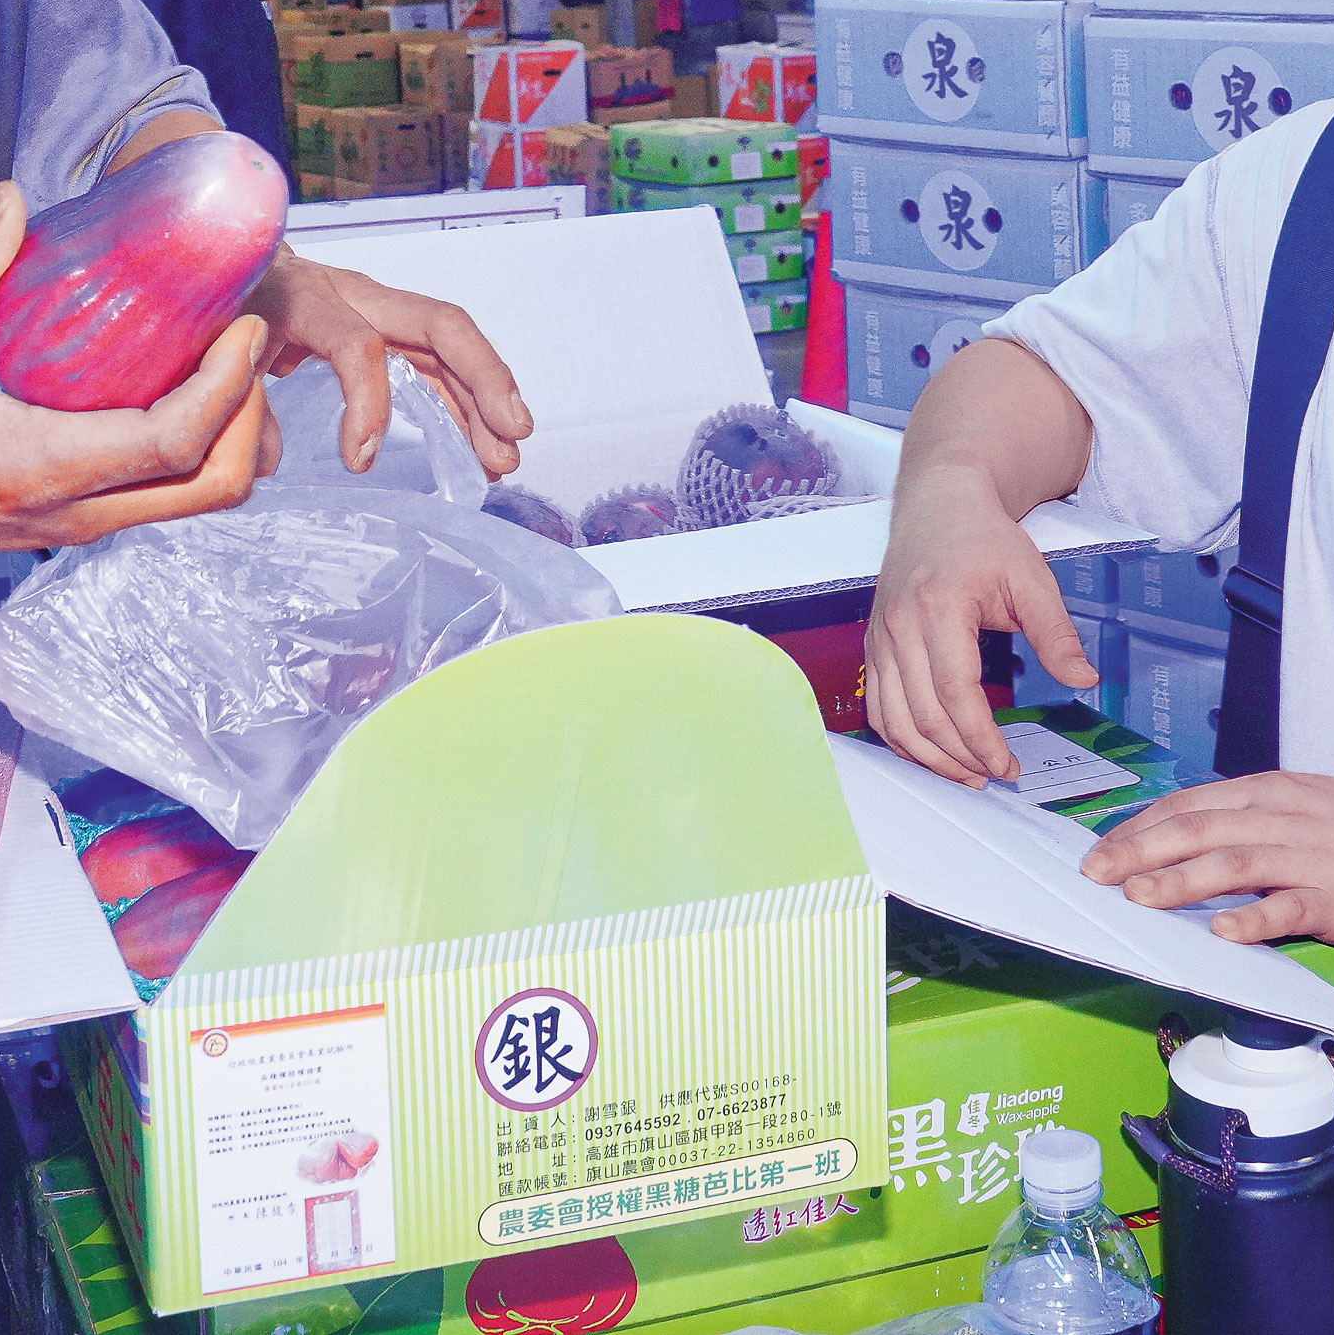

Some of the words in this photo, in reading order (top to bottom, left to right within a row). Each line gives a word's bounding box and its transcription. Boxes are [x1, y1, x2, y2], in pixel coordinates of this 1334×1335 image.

[922, 31, 969, 100] 泉
[1214, 64, 1261, 139] 泉
[938, 183, 986, 251] 泉
[1042, 753, 1084, 771] 公斤
[491, 1006, 585, 1094] 銀
[585, 1099, 637, 1123] 謝雪銀
[585, 1113, 681, 1141] 0937645592
[697, 1094, 787, 1122] 07-6623877
[968, 1099, 981, 1128] 佳冬
[993, 1085, 1064, 1111] Jiadong
[996, 1103, 1061, 1126] Wax-apple
[585, 1101, 842, 1163] 高雄市旗山區旗甲路一段280-1號
[586, 1128, 815, 1183] 旗山農會00037-22-1354860
[888, 1098, 1066, 1204] 黑珍
[498, 1149, 841, 1238] 農委會授權黑糖芭比第一班
[273, 1258, 288, 1268] 104
